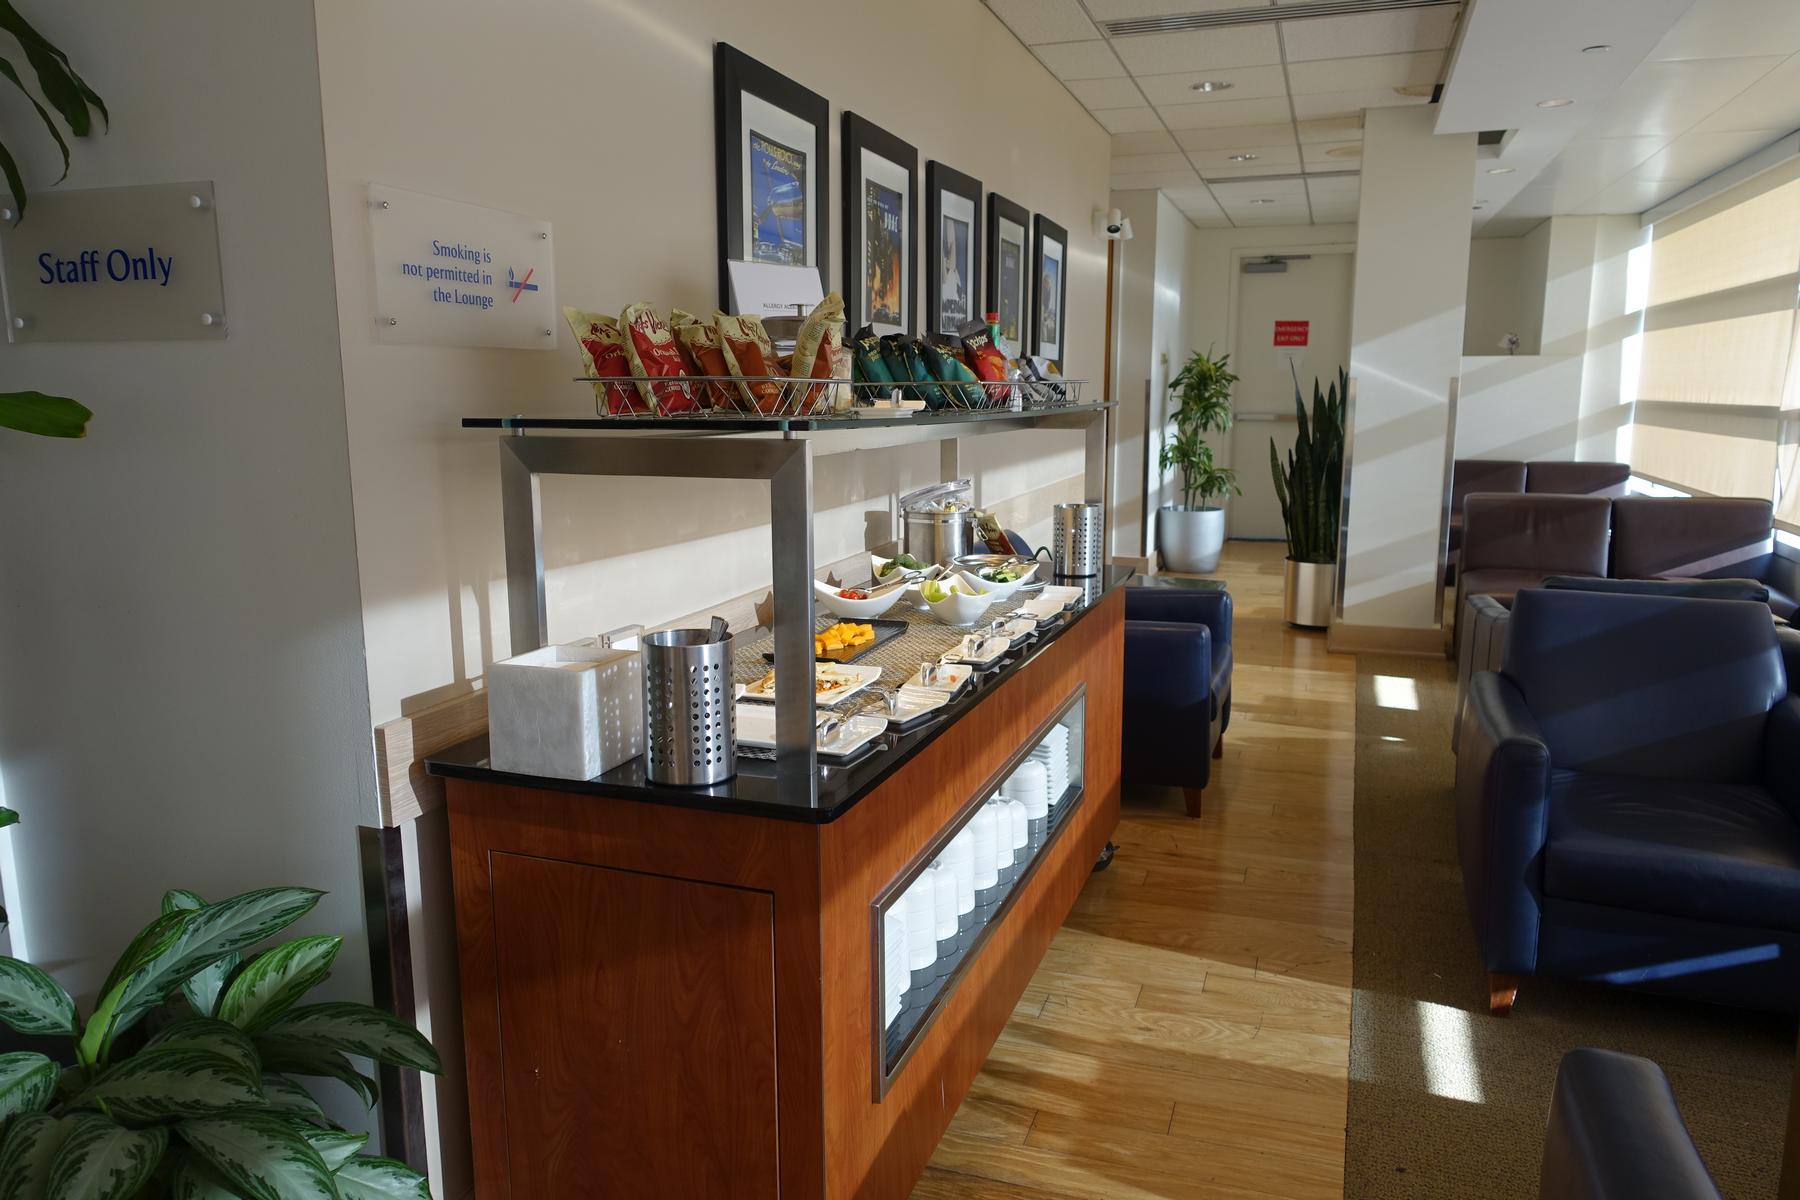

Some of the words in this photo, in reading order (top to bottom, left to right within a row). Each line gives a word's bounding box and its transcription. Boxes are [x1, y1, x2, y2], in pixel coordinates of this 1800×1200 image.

[432, 239, 481, 264] Smoking
[483, 248, 492, 263] is
[38, 250, 100, 284] Staff
[106, 247, 173, 287] Only
[402, 263, 423, 277] not
[426, 265, 480, 284] permitted
[482, 270, 492, 285] in
[433, 286, 452, 302] the
[455, 289, 494, 310] Lounge
